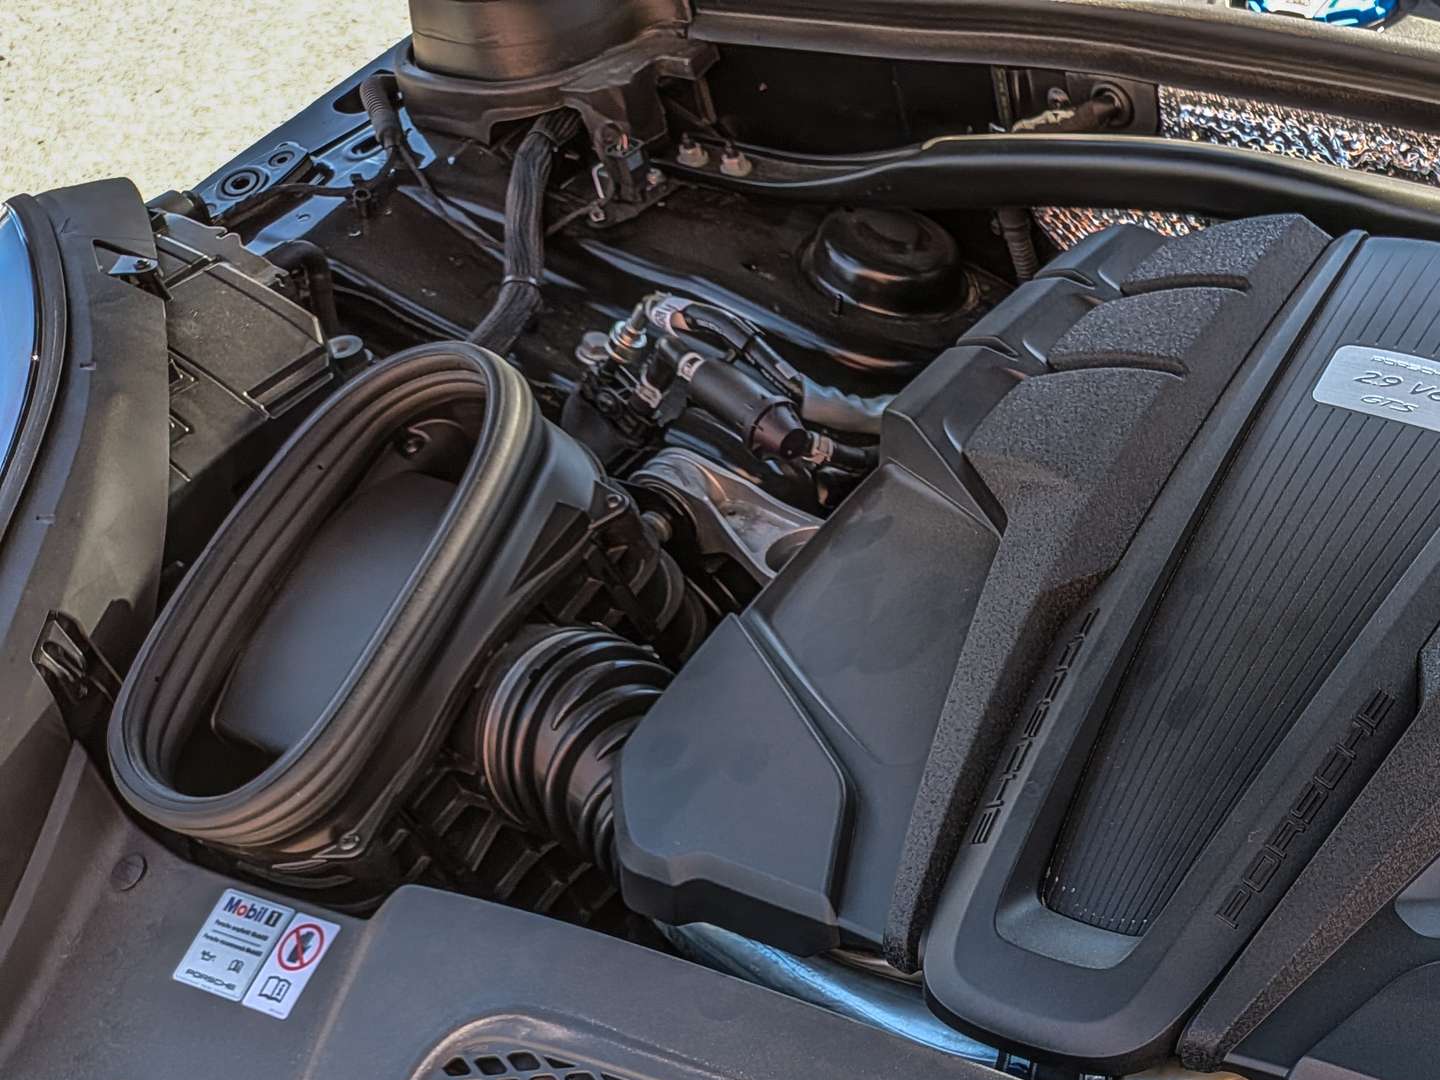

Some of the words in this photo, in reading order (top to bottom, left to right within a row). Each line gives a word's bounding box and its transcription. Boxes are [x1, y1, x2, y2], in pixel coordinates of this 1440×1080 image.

[1360, 395, 1420, 413] GTS
[1215, 690, 1396, 930] PORSCHE
[223, 896, 269, 922] Mobil
[265, 911, 282, 927] 1
[185, 969, 236, 990] PORSCHE
